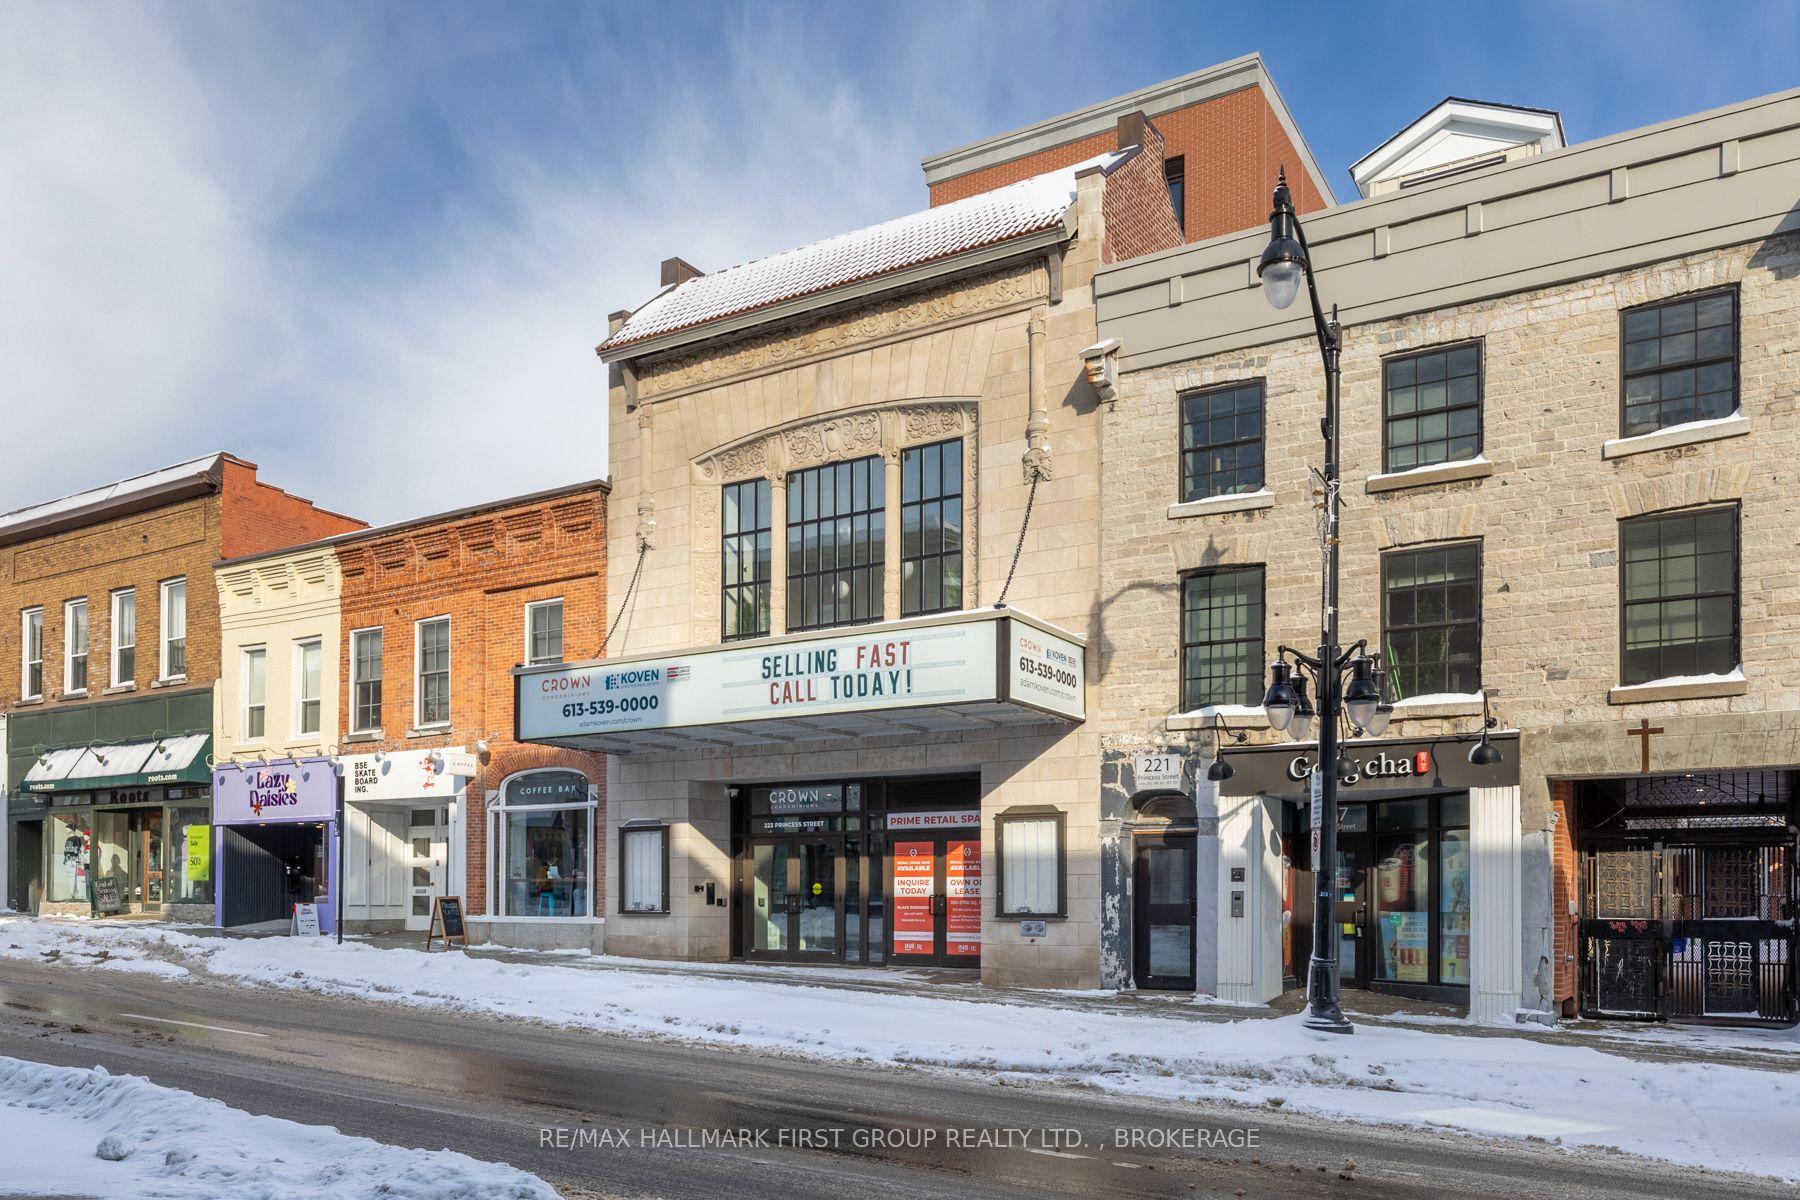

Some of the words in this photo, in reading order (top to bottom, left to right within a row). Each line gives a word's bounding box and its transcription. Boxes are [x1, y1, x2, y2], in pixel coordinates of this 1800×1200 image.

[762, 649, 837, 679] SELLING
[856, 641, 910, 669] FAST
[621, 669, 660, 685] KOVEN
[1020, 656, 1077, 688] 613-539-0000
[541, 675, 591, 692] CROWN
[770, 679, 817, 705] CALL
[831, 670, 911, 699] TODAY!
[562, 695, 659, 718] 613-539-0000
[354, 761, 368, 770] BSE
[1143, 757, 1169, 772] 221
[1290, 756, 1361, 784] Gg
[1365, 752, 1413, 776] cha
[148, 773, 178, 783] roots.com
[354, 769, 376, 778] SKATE
[29, 783, 55, 791] roots.com
[256, 771, 290, 792] Lazy
[354, 777, 379, 786] BOARD
[354, 785, 369, 793] ING.
[110, 790, 150, 804] Roots
[520, 786, 553, 795] COFFEE
[558, 784, 577, 793] BAR
[769, 789, 819, 804] CROWN
[249, 789, 298, 808] Daisies
[803, 820, 825, 828] STREET
[890, 816, 921, 826] PRIME
[924, 815, 958, 825] RETAIL
